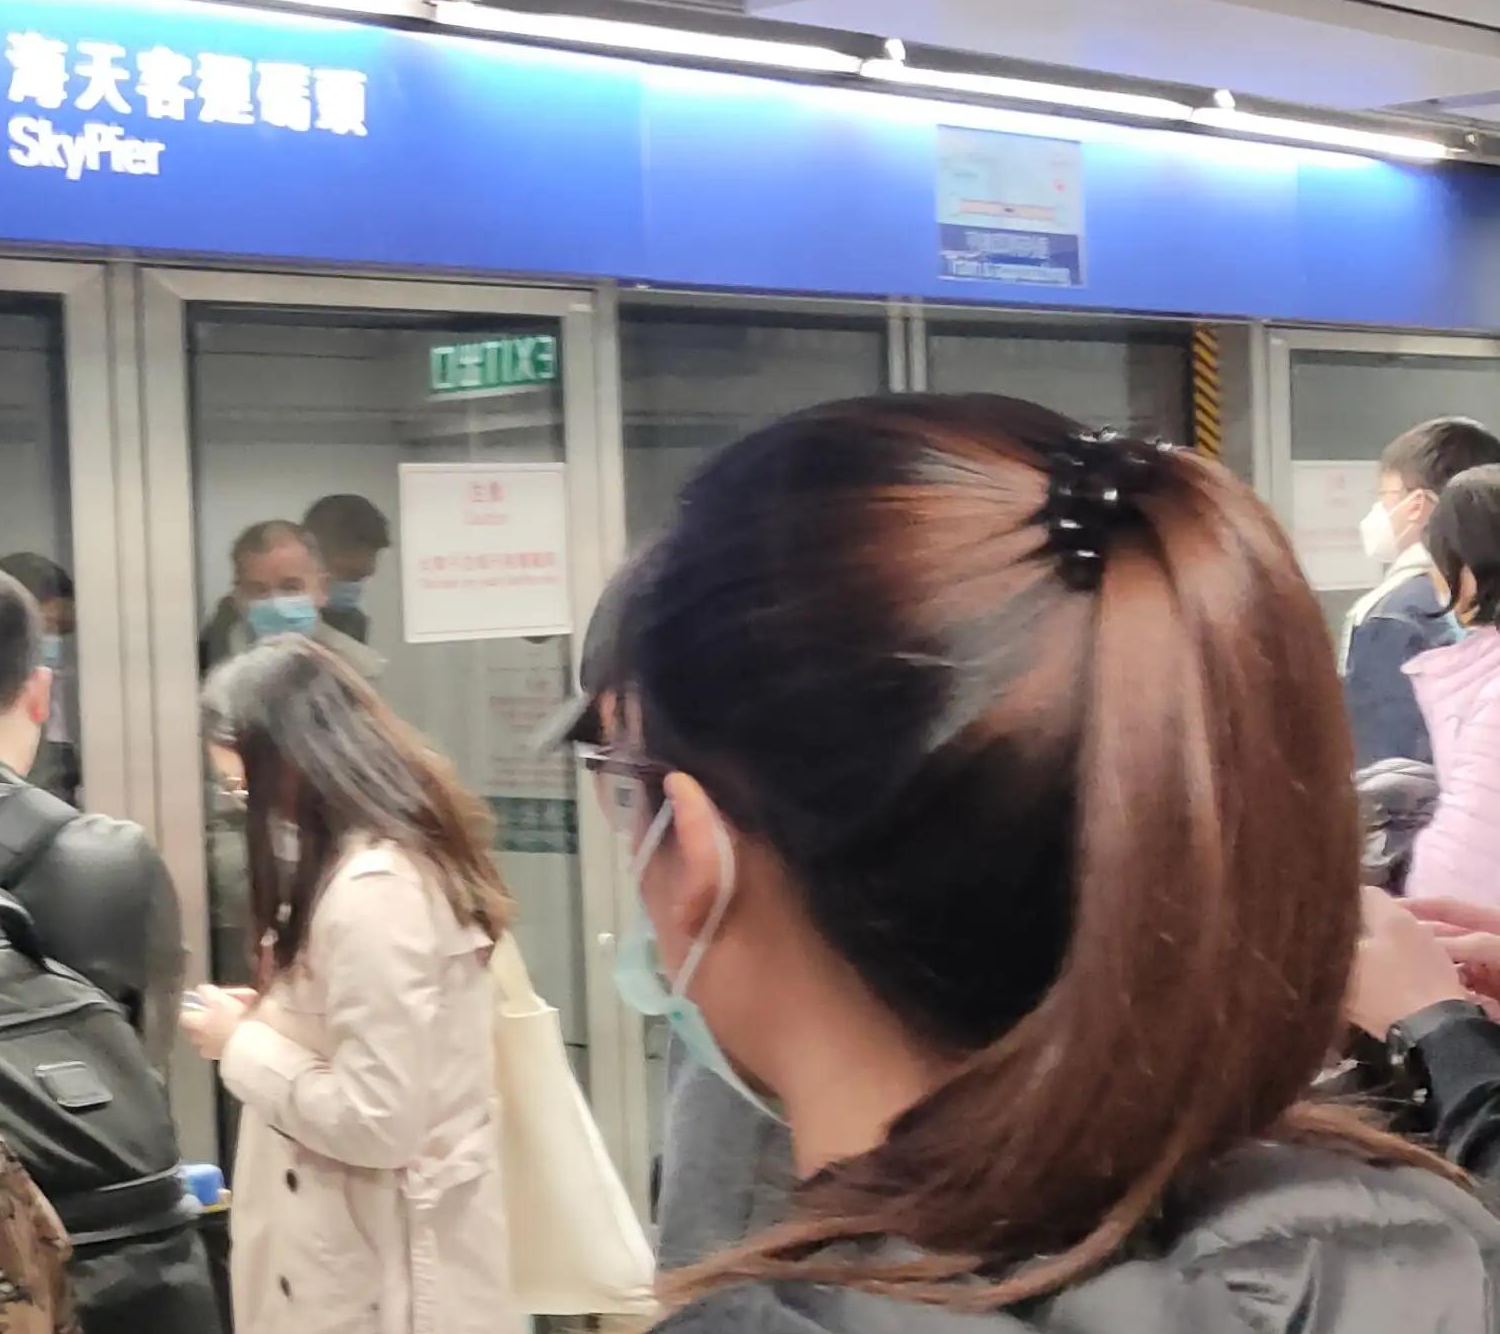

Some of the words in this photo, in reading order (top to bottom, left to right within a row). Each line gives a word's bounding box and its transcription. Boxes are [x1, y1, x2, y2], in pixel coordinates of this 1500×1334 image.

[5, 30, 368, 137] 海天客運碼頭
[7, 115, 166, 181] SkyPier
